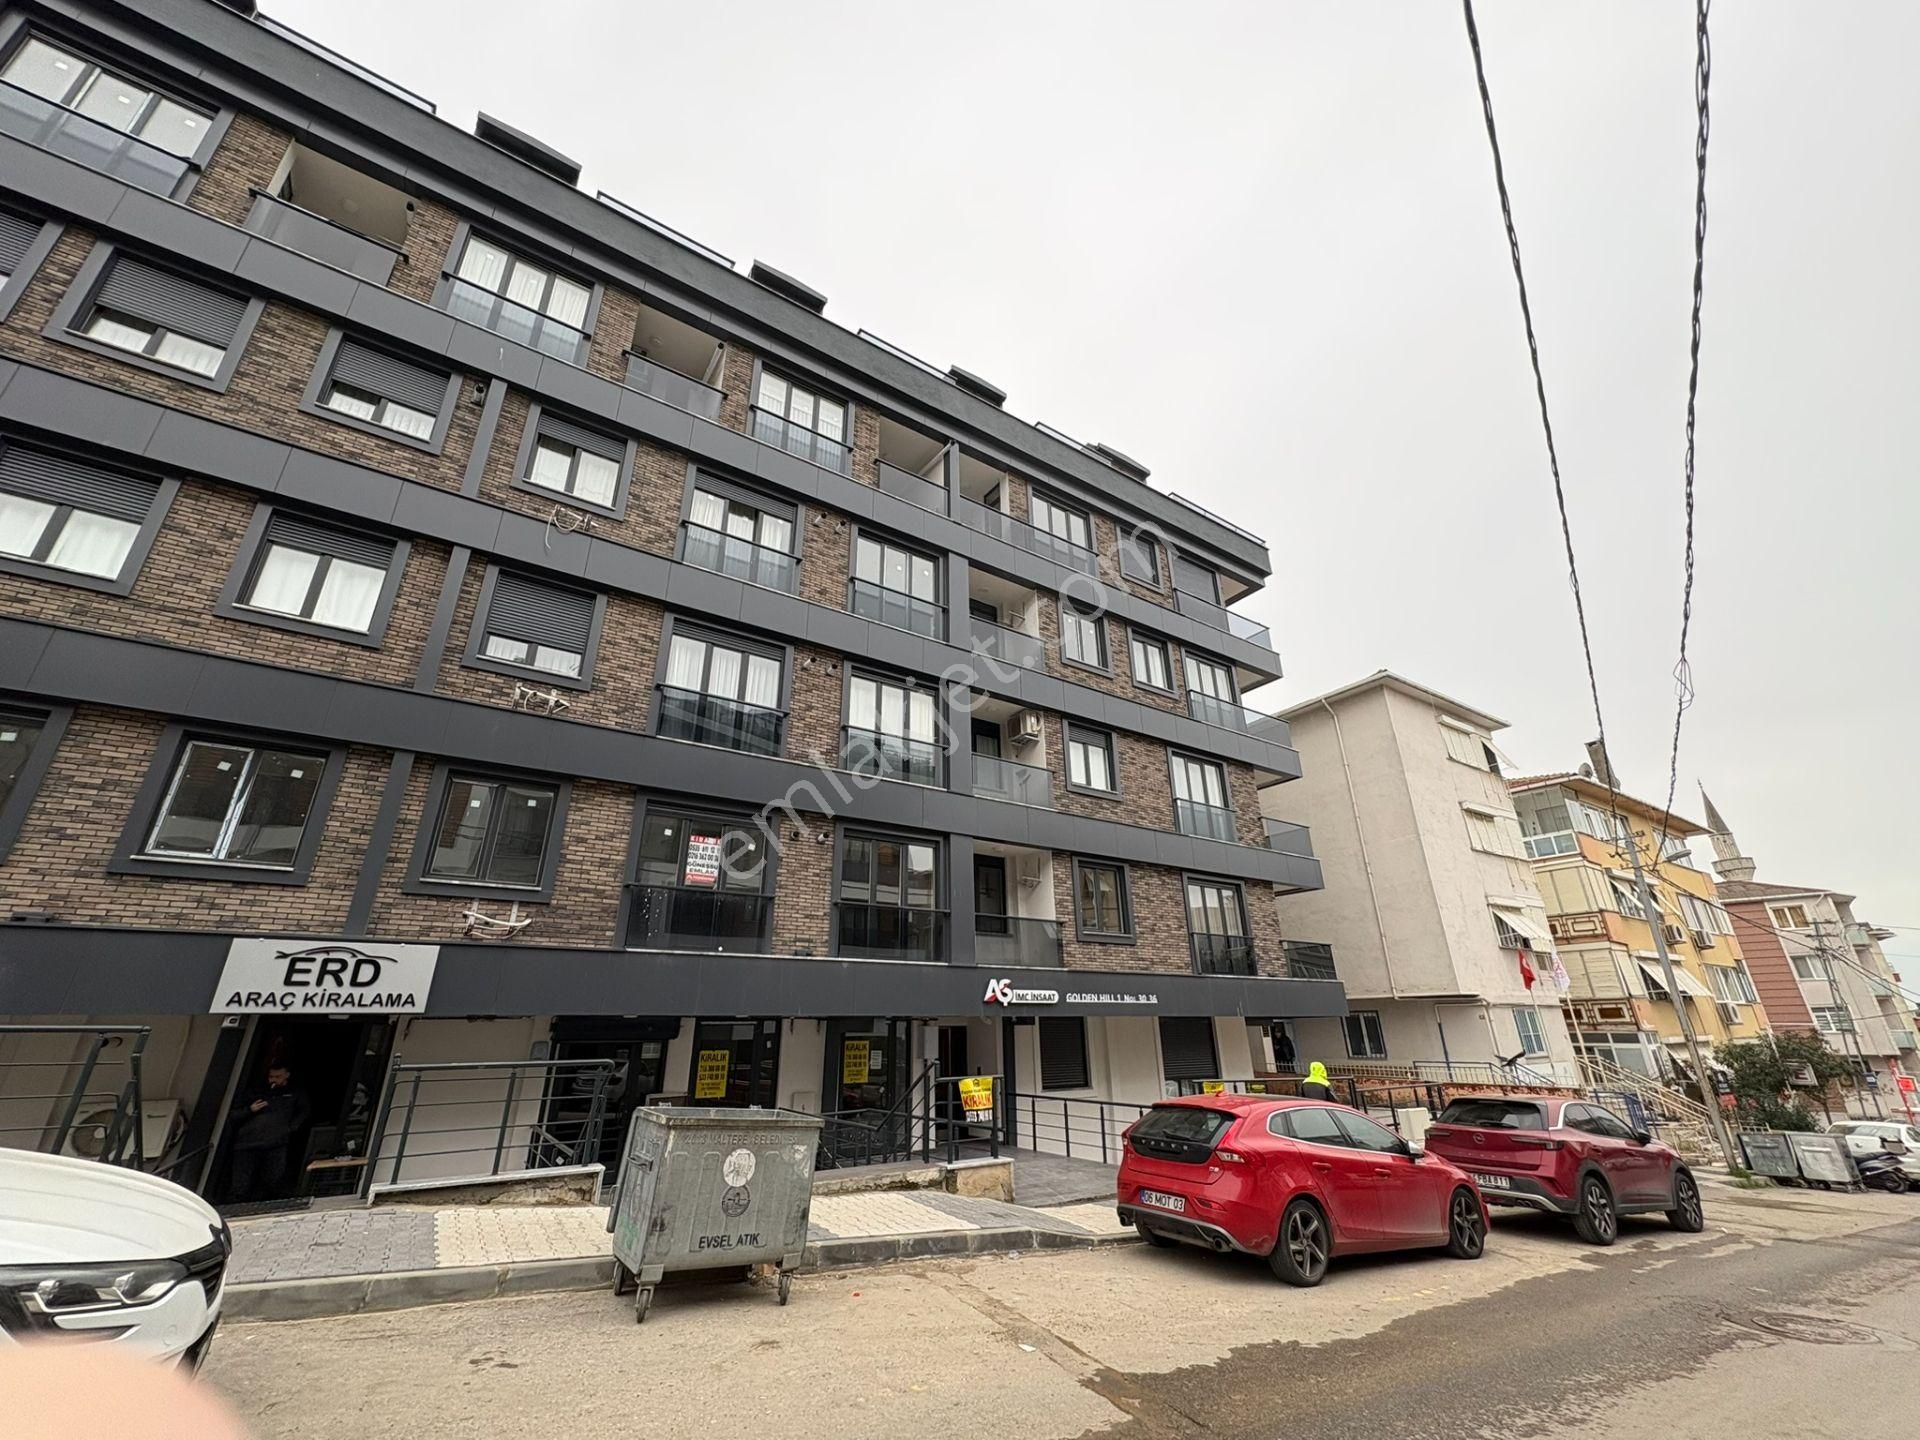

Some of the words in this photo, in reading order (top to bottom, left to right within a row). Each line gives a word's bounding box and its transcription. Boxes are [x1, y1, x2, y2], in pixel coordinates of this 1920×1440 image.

[283, 957, 382, 988] ERD
[225, 991, 297, 1011] ARAÇ
[301, 988, 416, 1009] KİRALAMA
[1154, 1192, 1171, 1207] MOT
[698, 1235, 731, 1249] EVSEL
[736, 1232, 761, 1247] ATIK
